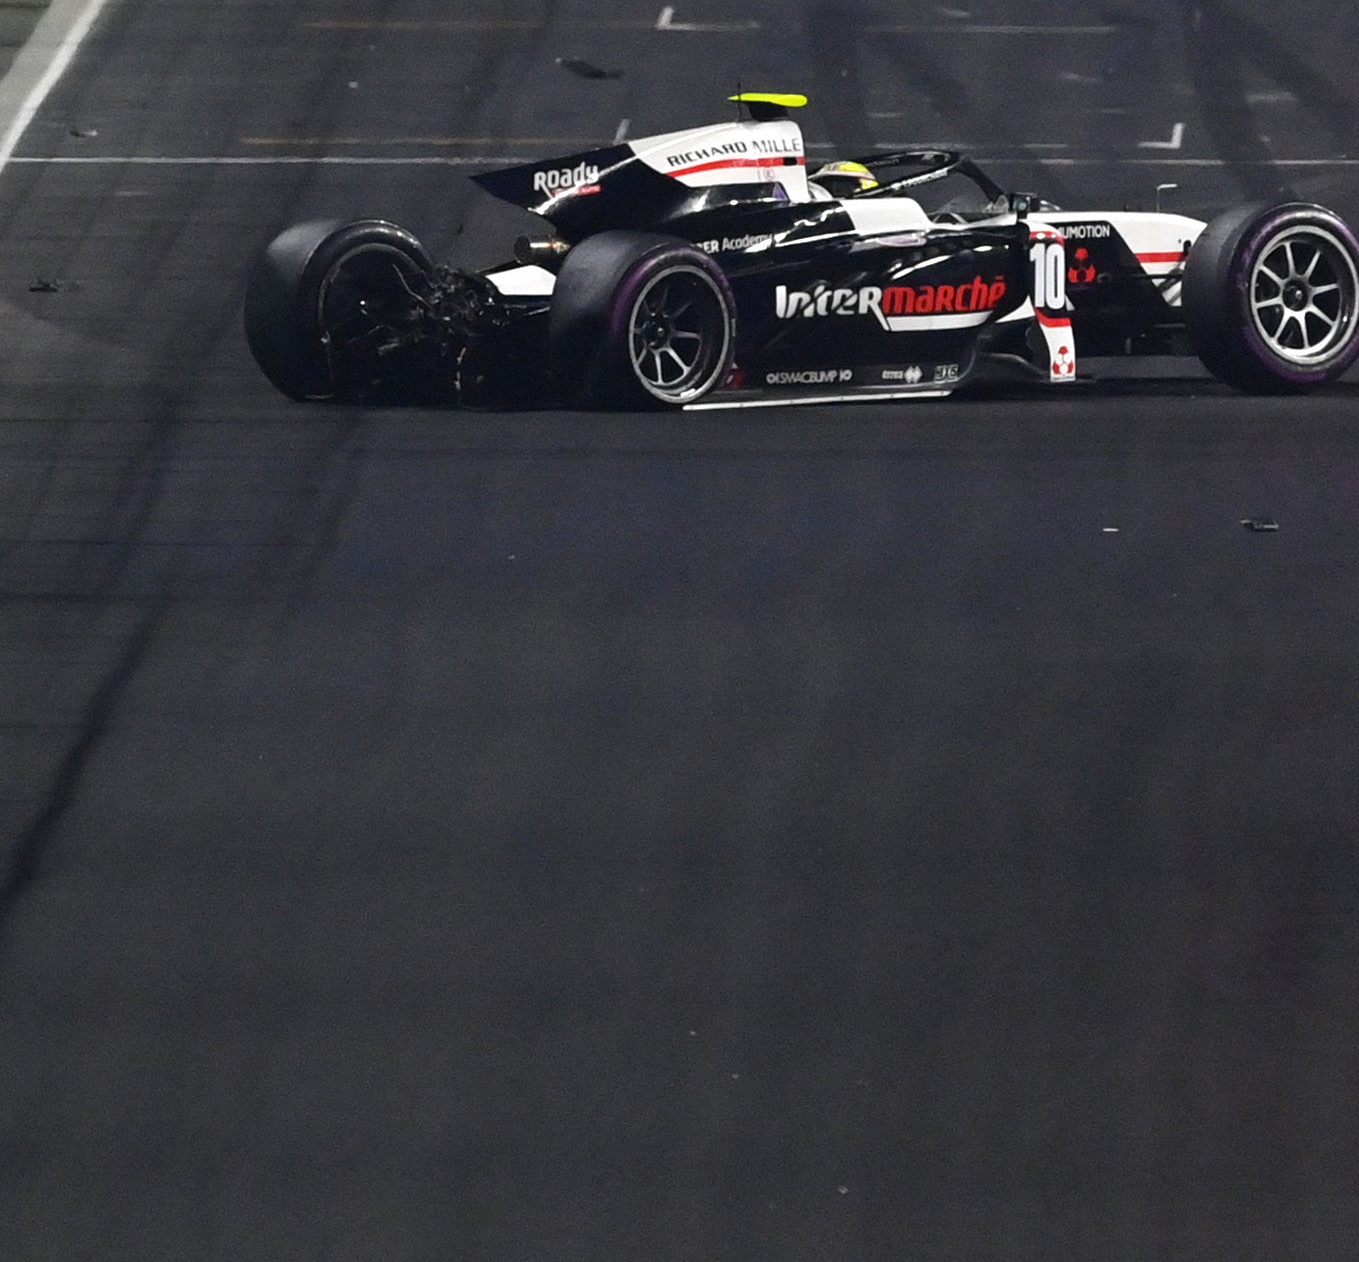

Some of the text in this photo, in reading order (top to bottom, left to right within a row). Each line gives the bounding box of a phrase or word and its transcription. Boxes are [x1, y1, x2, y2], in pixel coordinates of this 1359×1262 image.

[667, 138, 802, 167] RICHARD MILLE
[1029, 243, 1066, 310] 10
